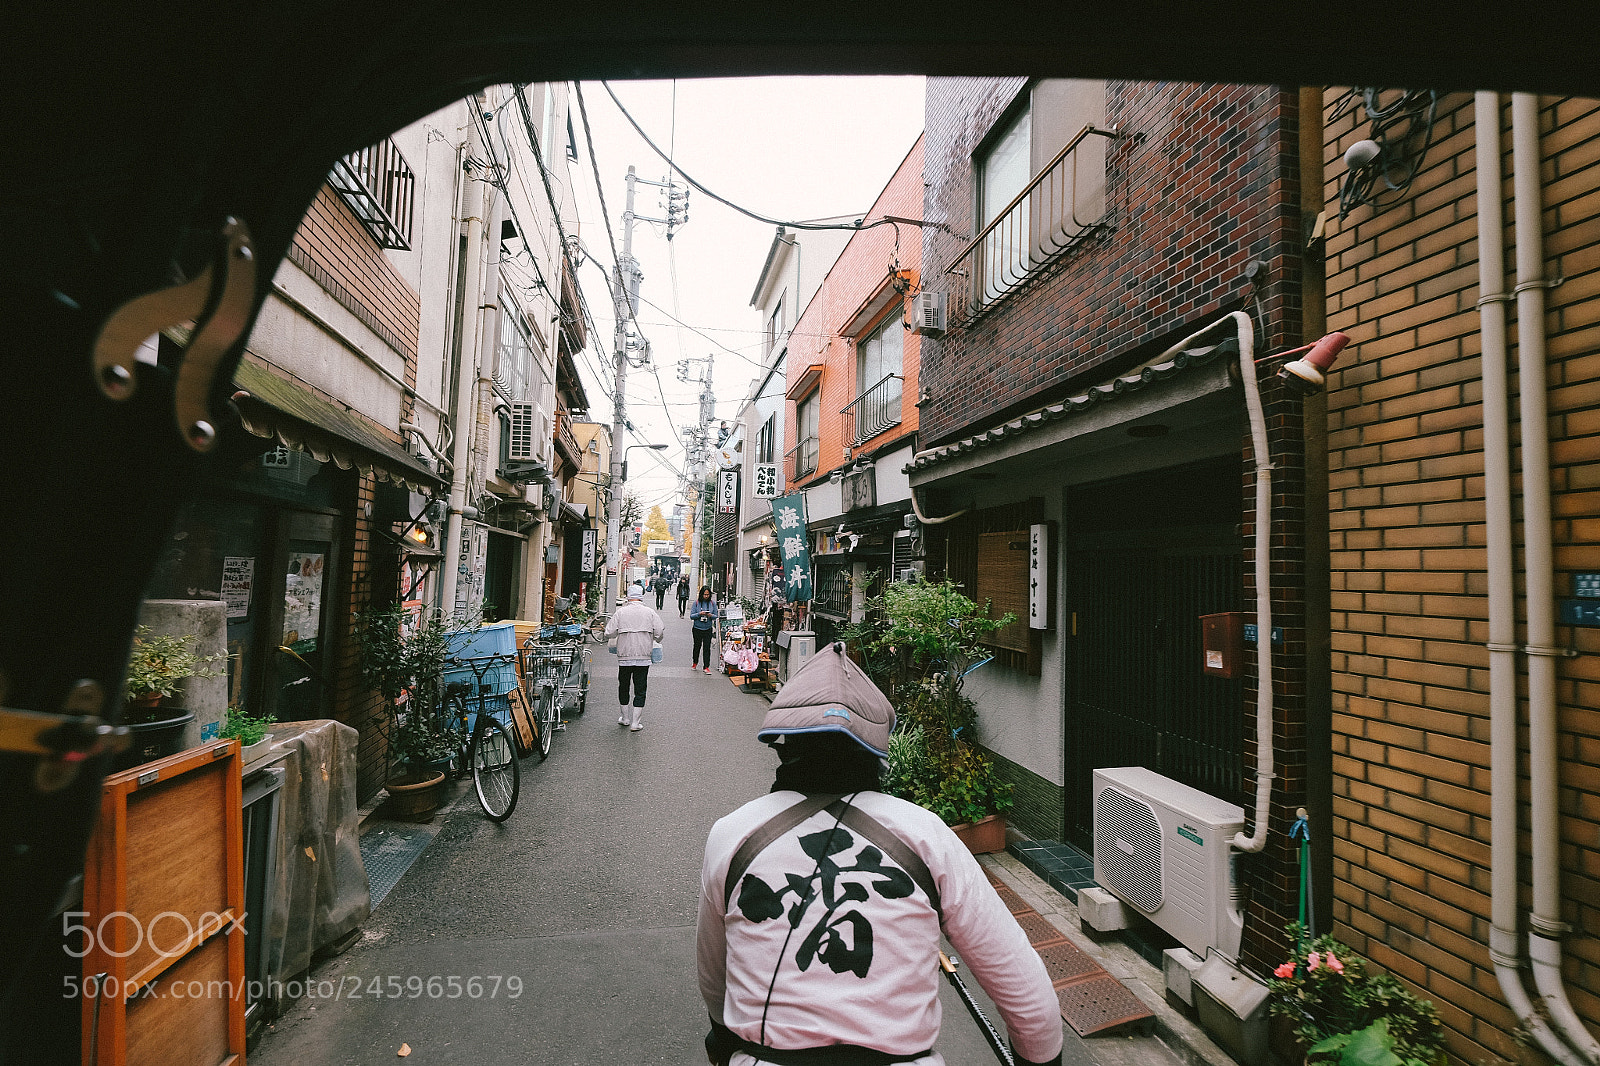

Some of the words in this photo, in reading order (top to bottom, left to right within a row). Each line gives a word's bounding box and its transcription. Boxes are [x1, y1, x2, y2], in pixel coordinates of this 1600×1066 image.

[725, 472, 733, 506] もんじゃ
[756, 466, 767, 495] べんてん
[766, 467, 776, 495] 和小物
[778, 505, 807, 589] 海鮮丼
[1271, 631, 1278, 641] 4
